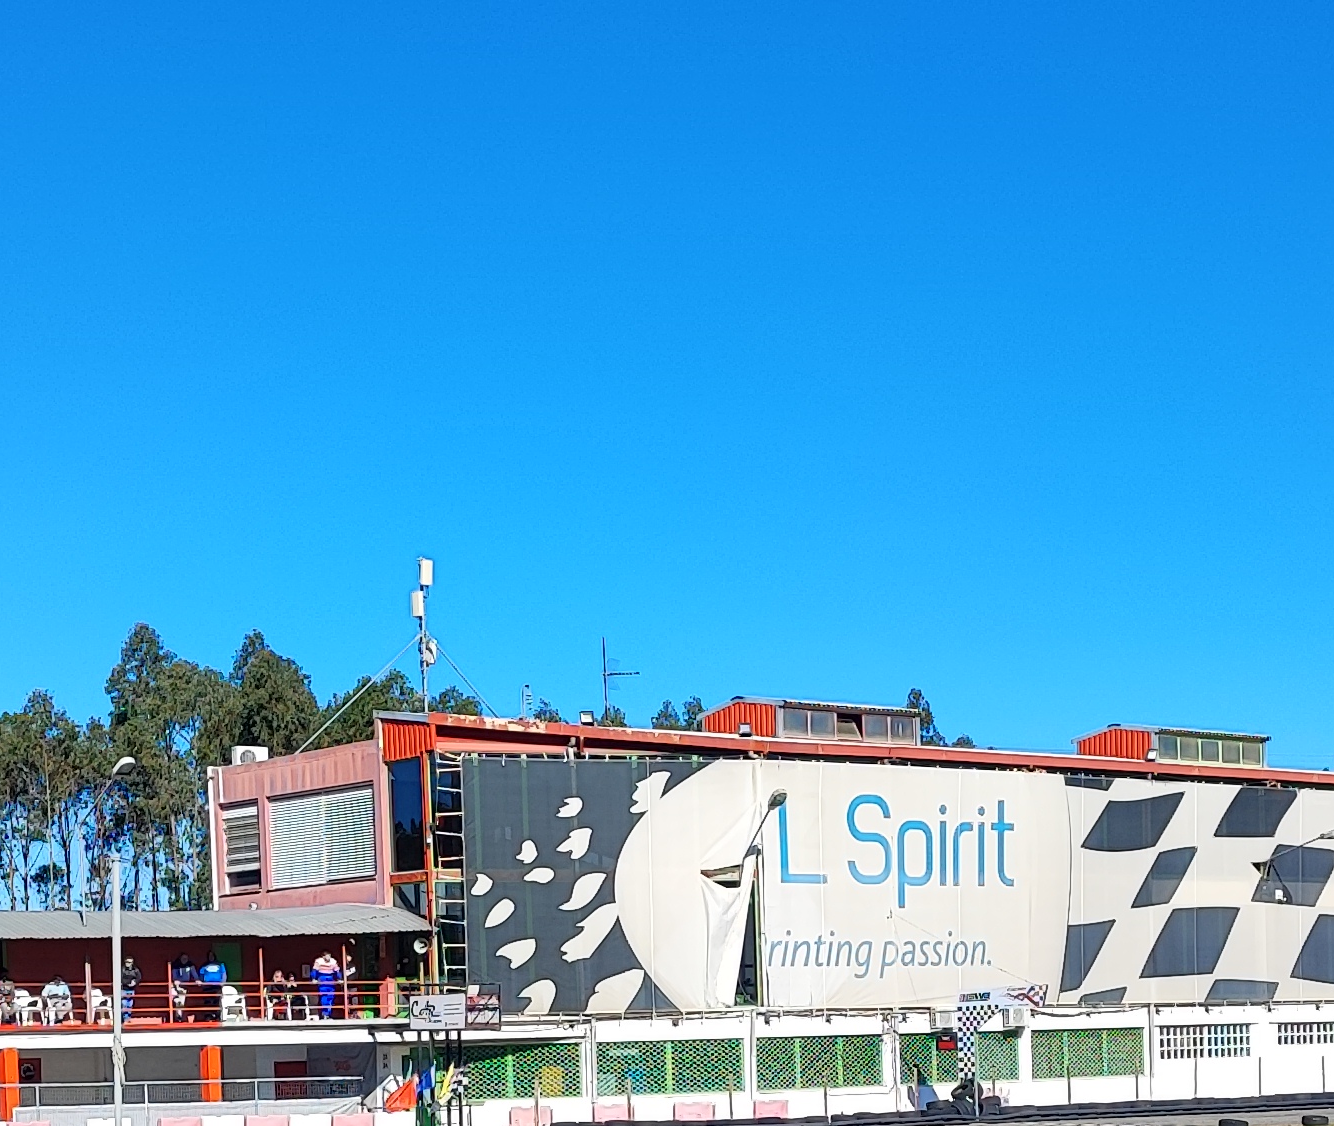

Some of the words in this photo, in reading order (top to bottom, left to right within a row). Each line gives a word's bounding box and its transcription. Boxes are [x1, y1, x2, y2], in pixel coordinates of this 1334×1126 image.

[846, 794, 1015, 909] Spirit
[766, 930, 873, 979] rinting
[879, 930, 992, 979] passion.
